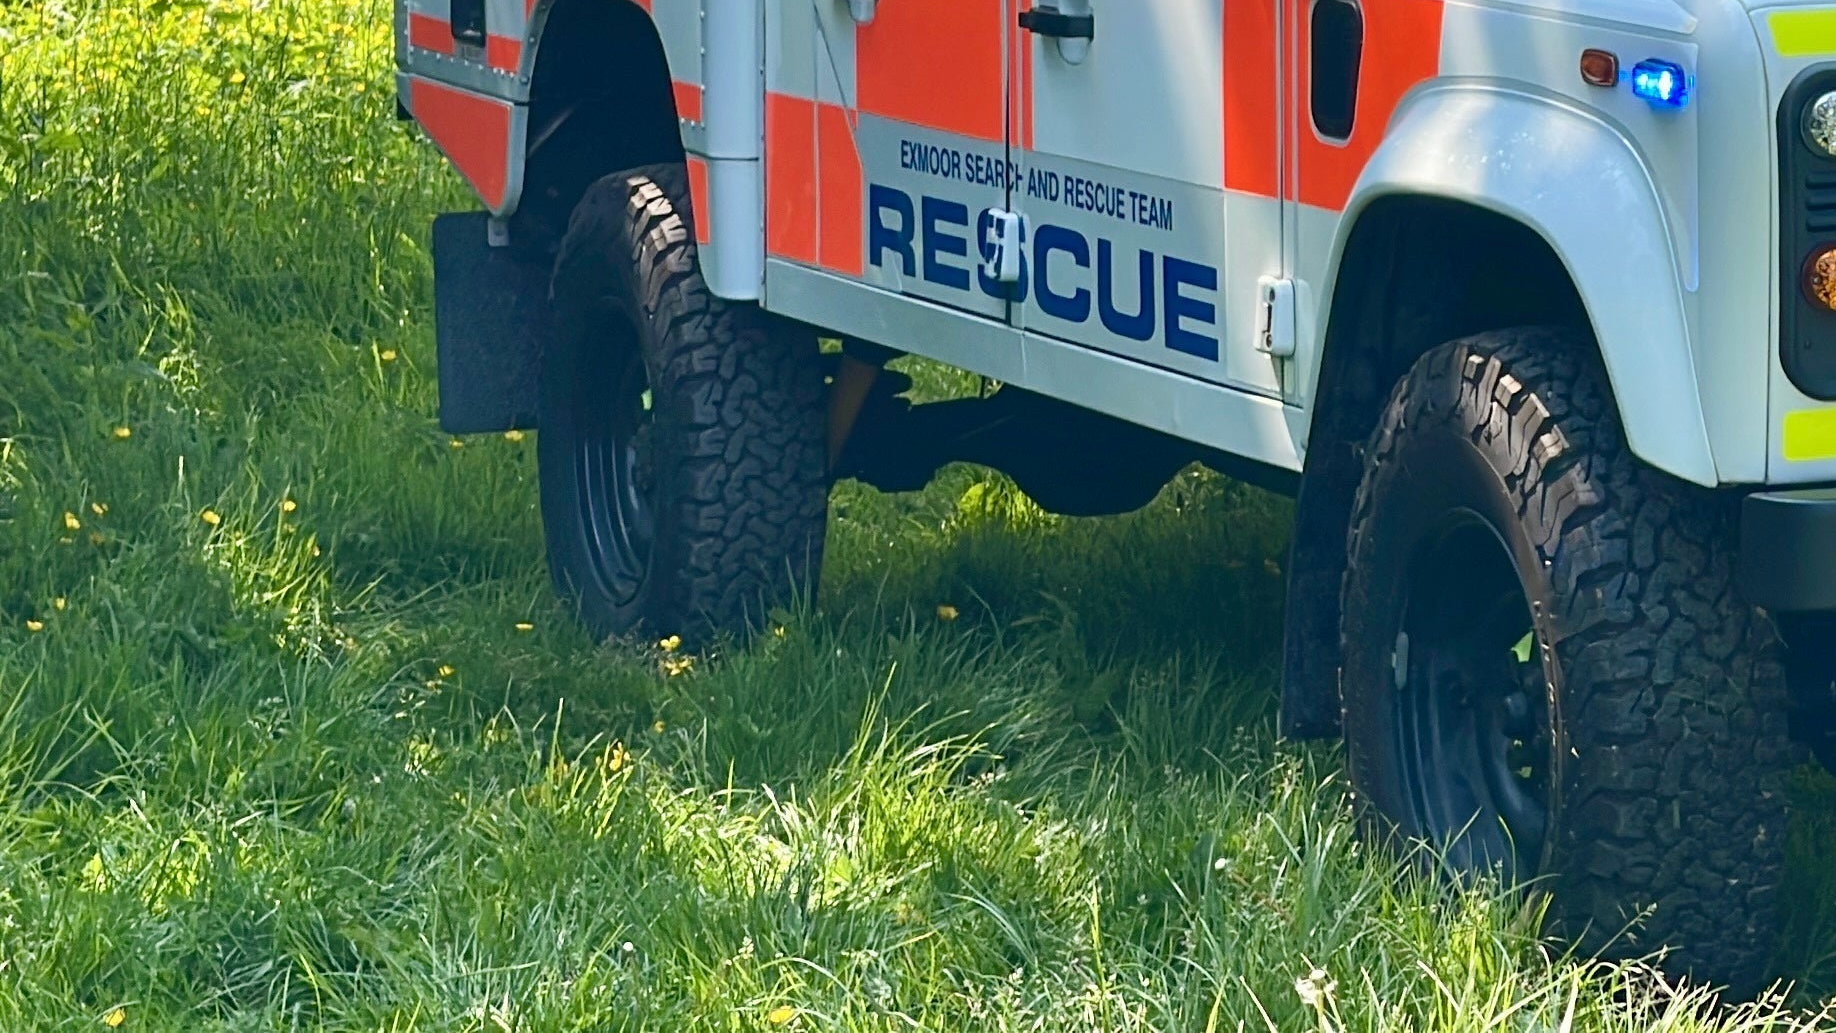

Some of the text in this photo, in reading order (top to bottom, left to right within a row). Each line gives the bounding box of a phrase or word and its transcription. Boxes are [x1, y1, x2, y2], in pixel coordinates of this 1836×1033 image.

[901, 140, 961, 180] EXMOOR
[1028, 167, 1059, 202] AND
[1064, 175, 1125, 220] RESCUE
[1129, 190, 1173, 231] TEAM
[869, 183, 1219, 363] RESCUE
